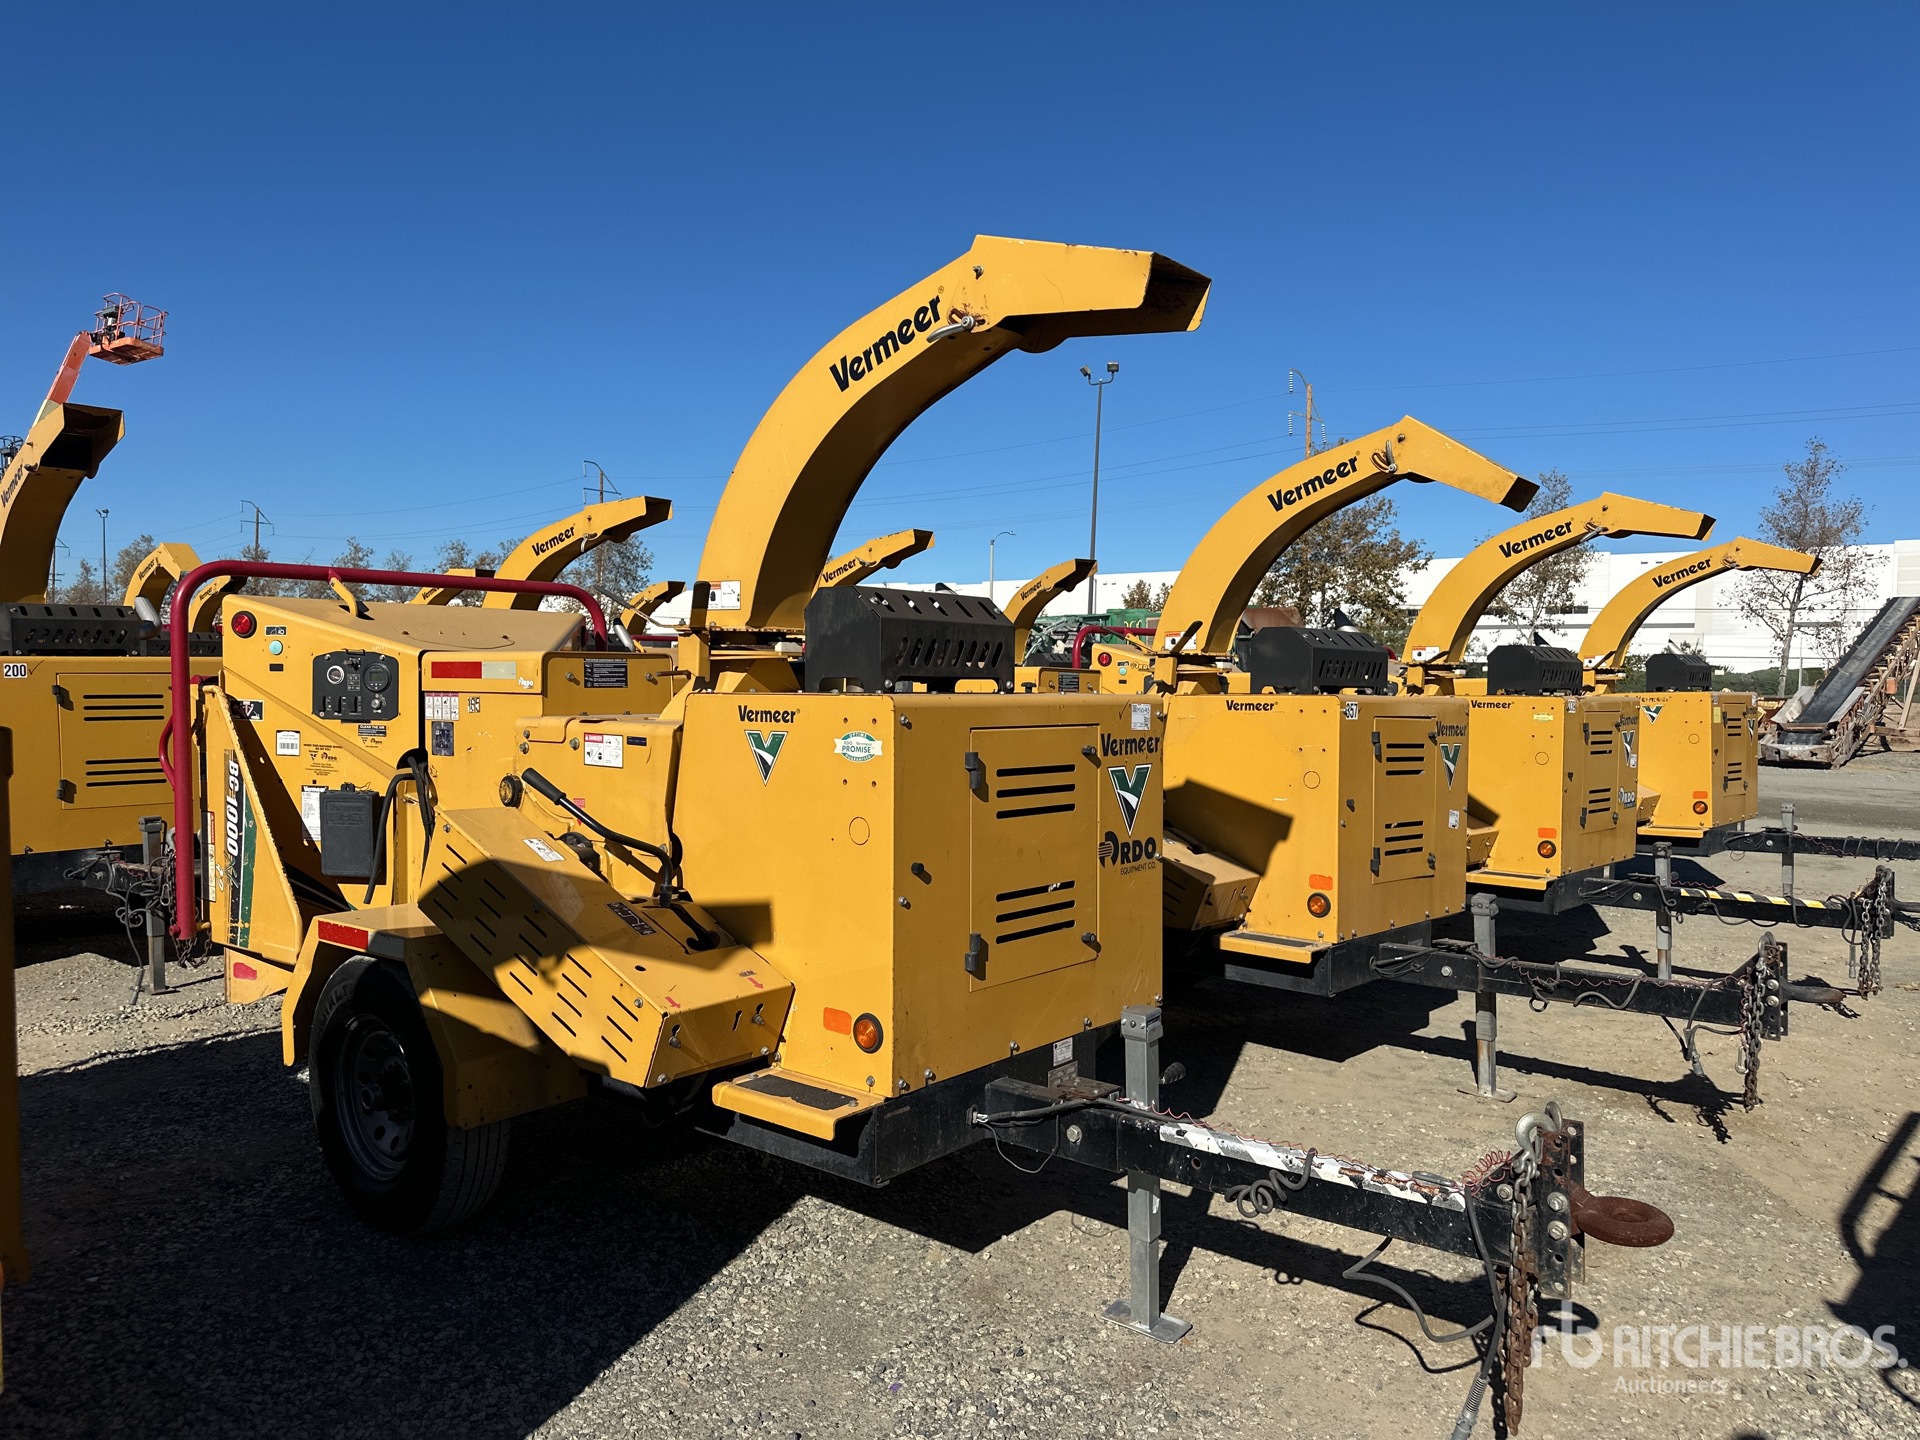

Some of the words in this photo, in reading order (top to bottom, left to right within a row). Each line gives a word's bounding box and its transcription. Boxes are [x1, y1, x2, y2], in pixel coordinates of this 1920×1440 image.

[829, 294, 941, 393] Vermeer
[1266, 455, 1358, 512] Vermeer
[531, 525, 575, 556] Vermeer
[1498, 521, 1573, 558] Vermeer
[822, 558, 857, 583] Vermeer
[1652, 558, 1712, 588] Vermeer
[4, 664, 27, 677] 200
[738, 705, 797, 724] Vermeer
[1226, 700, 1275, 711] Vermeer
[1471, 700, 1512, 709] Vermeer
[1436, 720, 1467, 737] Vermeer
[842, 745, 871, 754] PROMISE
[1101, 733, 1160, 757] Vermeer
[1120, 836, 1157, 865] RDO
[1120, 863, 1147, 876] EQUIPMENT
